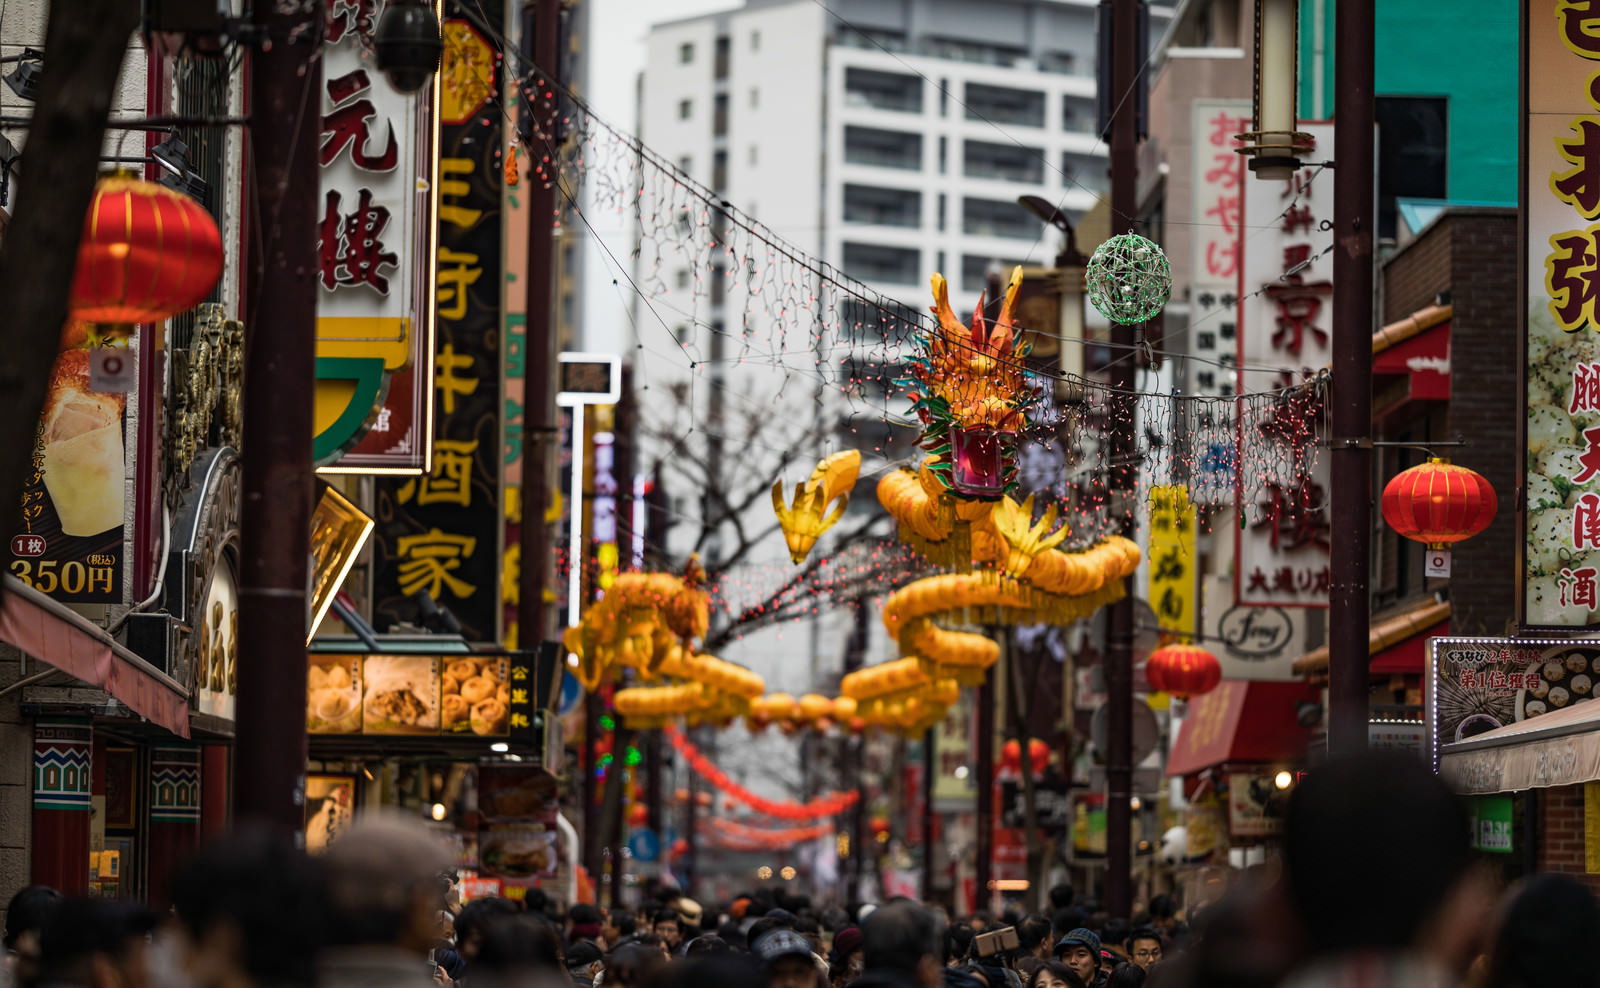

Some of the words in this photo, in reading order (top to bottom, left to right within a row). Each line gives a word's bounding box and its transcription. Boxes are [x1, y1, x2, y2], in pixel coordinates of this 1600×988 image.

[17, 538, 43, 554] 1枚
[10, 559, 114, 594] 350円
[1460, 667, 1541, 690] 第1位獲得
